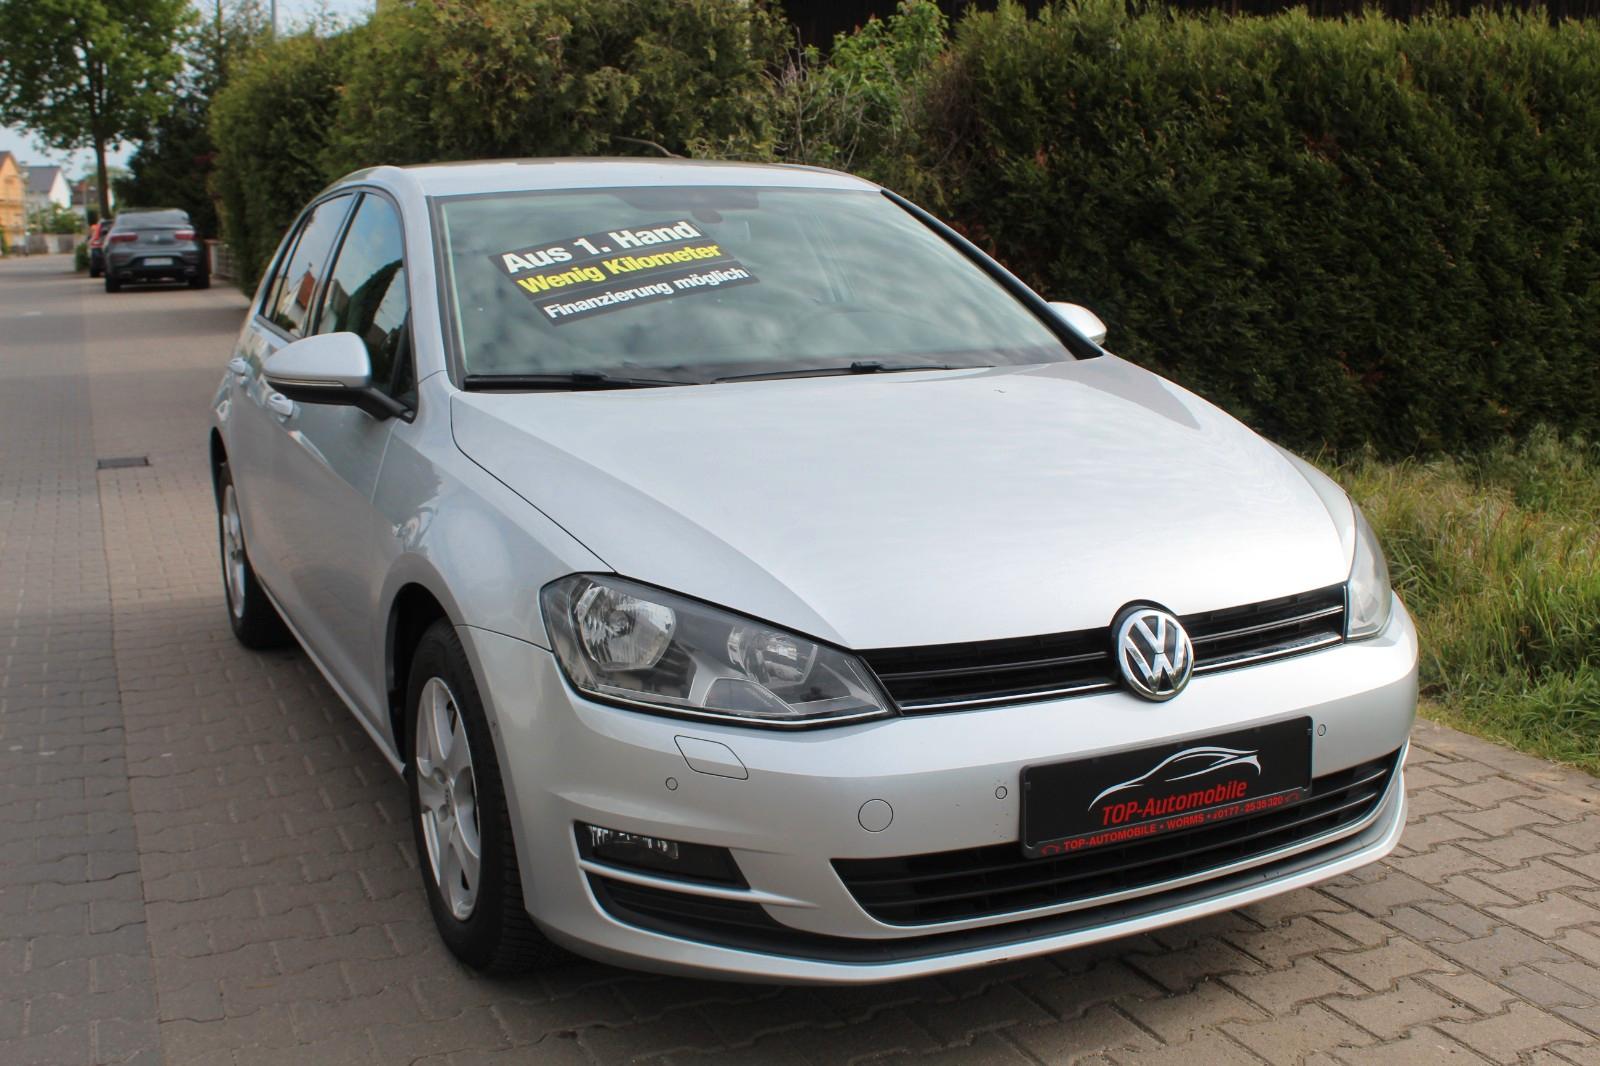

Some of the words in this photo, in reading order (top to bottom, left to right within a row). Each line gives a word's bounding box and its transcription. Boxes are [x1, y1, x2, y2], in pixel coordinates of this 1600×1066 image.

[502, 247, 573, 273] Aus
[573, 237, 612, 256] 1.
[608, 221, 702, 250] Hand
[517, 264, 607, 293] Wenig
[602, 243, 722, 275] Kilometer
[543, 281, 674, 318] Finanzierung
[673, 266, 750, 290] möglich
[1102, 780, 1248, 825] TOP-Automobile
[1063, 823, 1157, 851] TOP-AUTOMOBILE
[1166, 813, 1204, 830] WORMS
